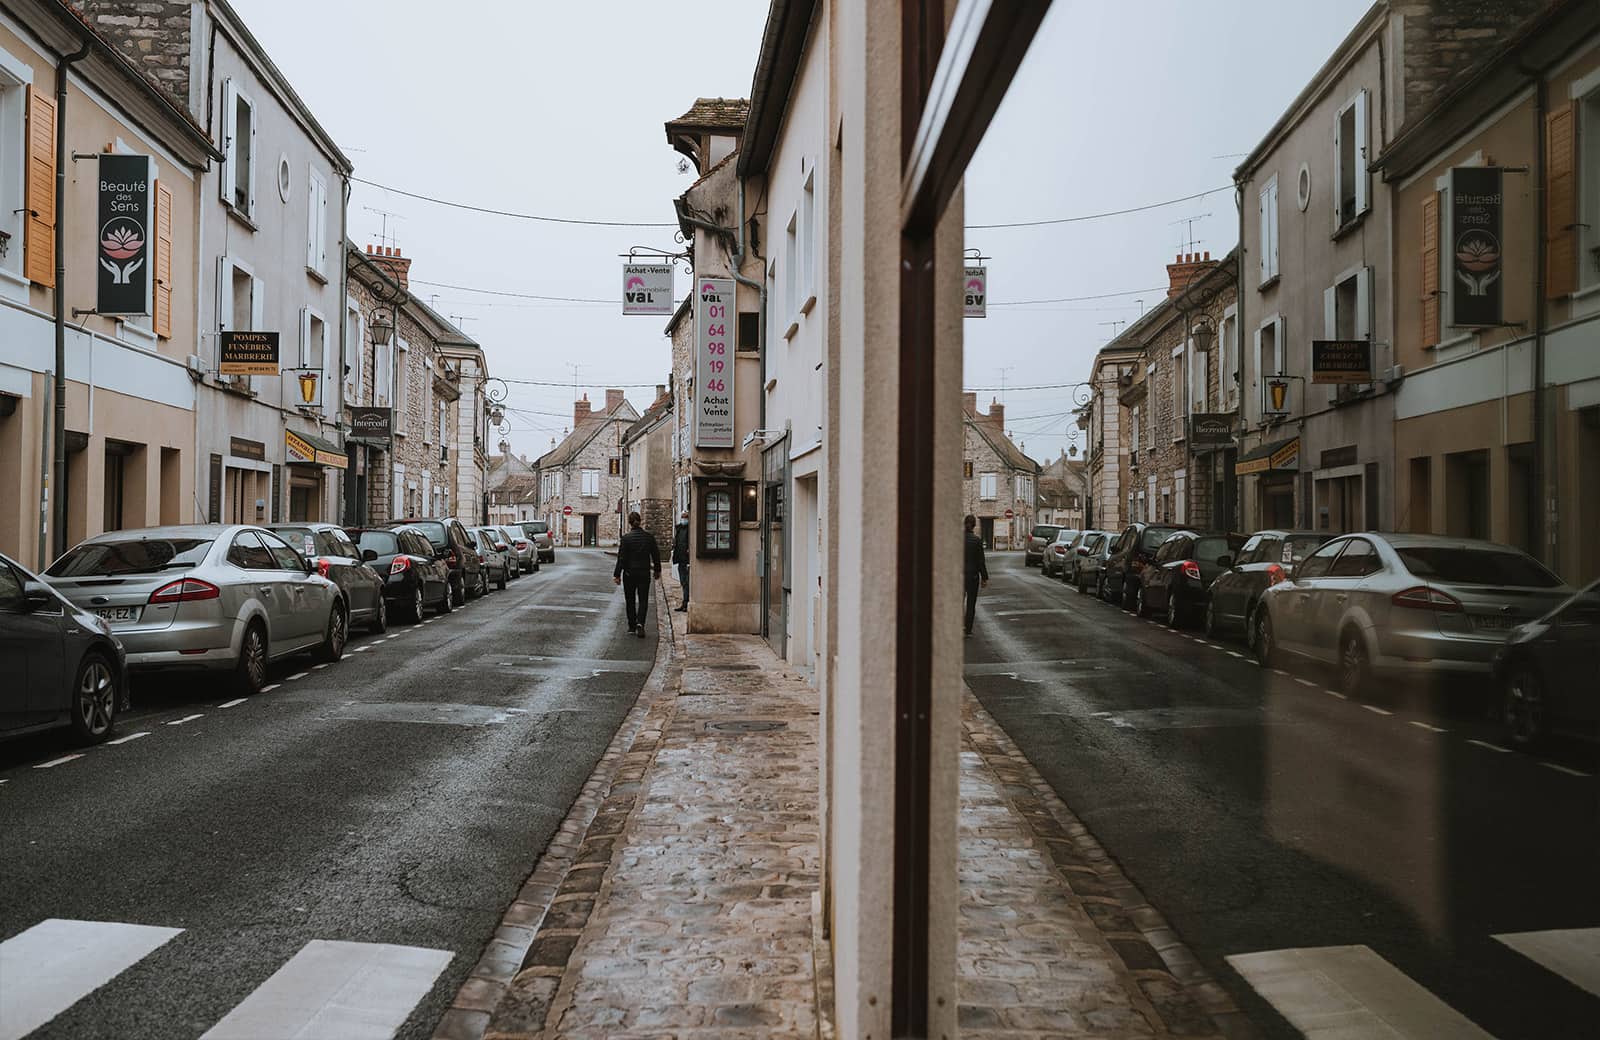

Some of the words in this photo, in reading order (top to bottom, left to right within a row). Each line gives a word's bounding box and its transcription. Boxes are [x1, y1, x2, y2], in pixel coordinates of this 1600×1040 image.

[100, 180, 146, 192] Beauté
[115, 193, 132, 201] des
[110, 200, 139, 212] Sens
[709, 305, 725, 318] 01
[708, 324, 725, 337] 64
[233, 333, 268, 341] POMPES
[708, 342, 725, 355] 98
[709, 360, 725, 374] 19
[707, 378, 725, 392] 46
[703, 396, 729, 405] Achat
[703, 407, 729, 416] Vente
